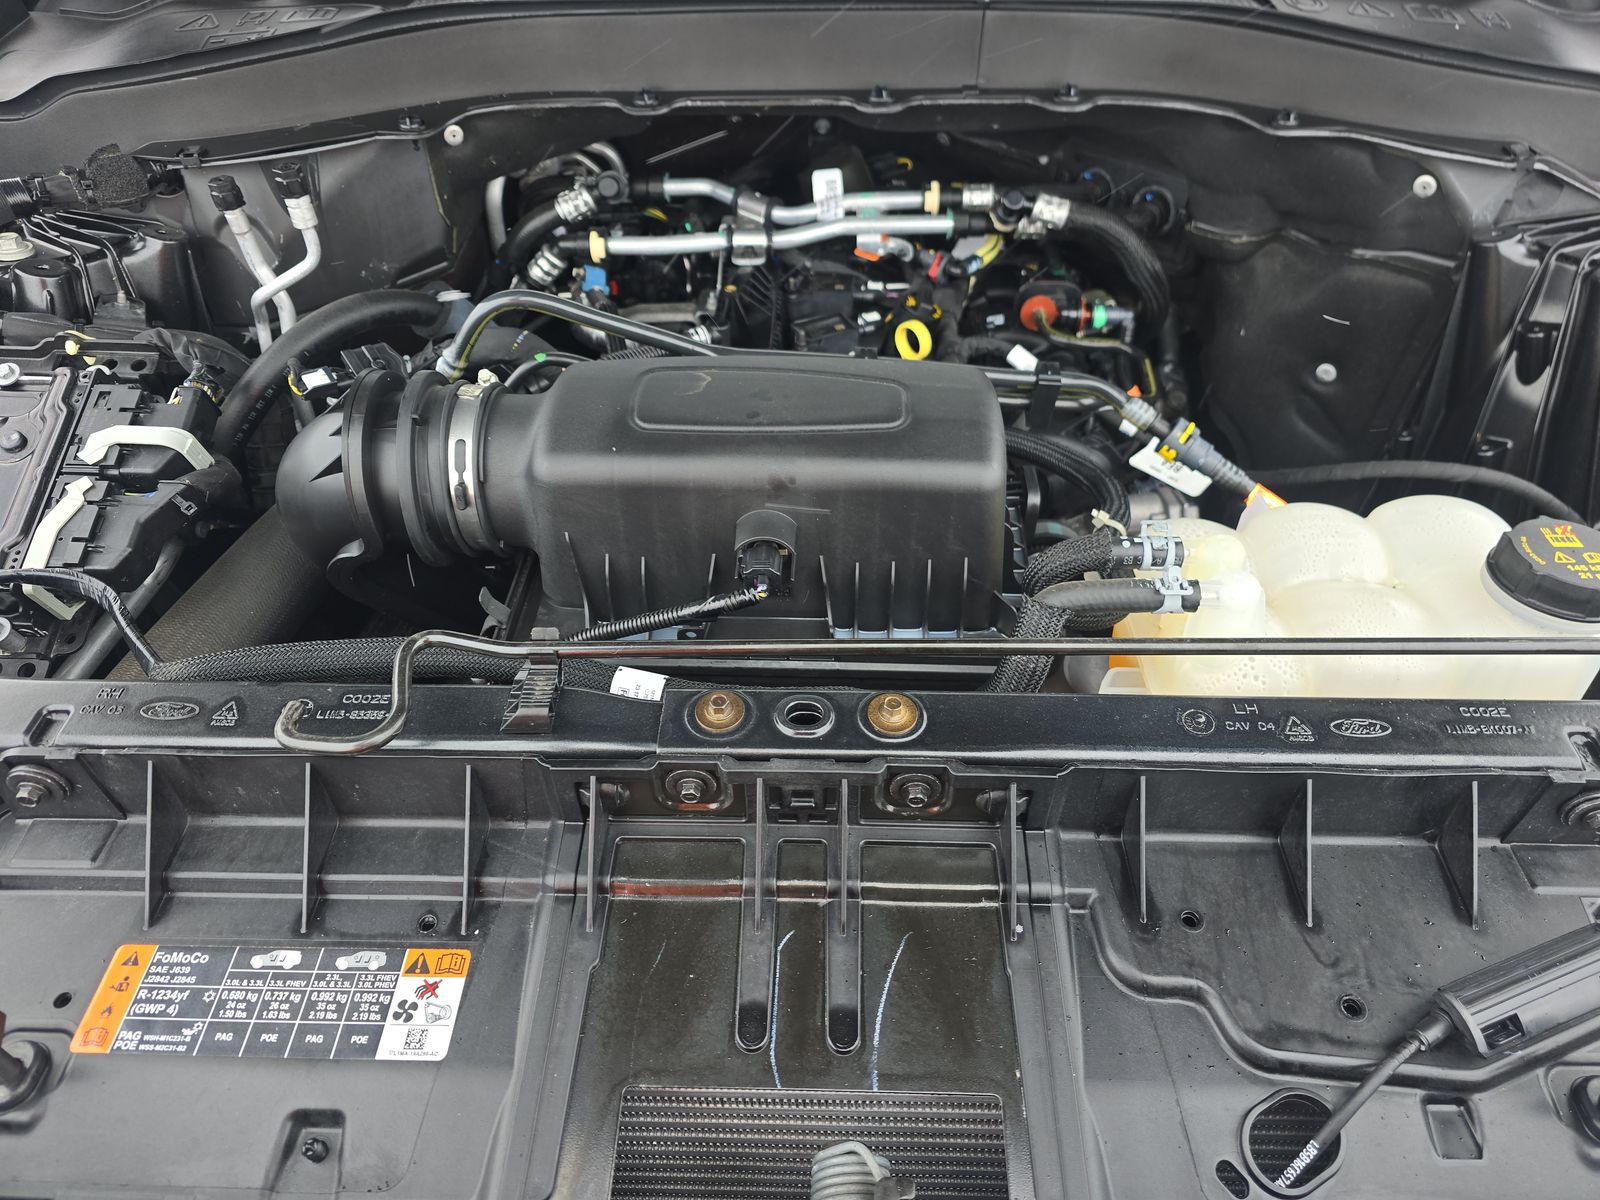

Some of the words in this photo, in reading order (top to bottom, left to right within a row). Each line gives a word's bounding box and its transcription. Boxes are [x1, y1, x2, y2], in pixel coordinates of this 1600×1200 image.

[96, 688, 126, 700] RH
[146, 702, 193, 718] Ford
[1232, 703, 1259, 714] LH
[1225, 721, 1250, 731] CAV
[1339, 719, 1383, 735] Ford
[152, 952, 210, 964] FoMoCo
[149, 966, 170, 974] SAE
[170, 966, 191, 974] J639
[170, 976, 197, 984] J2845
[136, 989, 190, 1002] R-1234yf
[221, 990, 246, 1000] 0.680
[246, 991, 258, 1002] kg
[264, 991, 289, 1001] 0.737
[289, 992, 302, 1003] kg
[311, 992, 335, 1001] 0.992
[336, 992, 348, 1004] kg
[354, 993, 378, 1002] 0.992
[379, 993, 391, 1004] kg
[225, 1001, 236, 1009] 24
[269, 1002, 279, 1010] 26
[316, 1002, 326, 1010] 35
[359, 1003, 369, 1011] 35
[130, 1004, 165, 1015] (GWP
[166, 1004, 179, 1016] 4)
[219, 1010, 234, 1018] 1.50
[234, 1010, 247, 1018] lbs
[262, 1011, 278, 1019] 1.63
[278, 1011, 291, 1019] lbs
[308, 1011, 325, 1019] 2.19
[325, 1012, 338, 1020] lbs
[352, 1012, 368, 1020] 2.19
[369, 1013, 381, 1021] lbs
[118, 1031, 142, 1040] PAG
[214, 1033, 234, 1041] PAG
[260, 1034, 279, 1042] POE
[305, 1034, 324, 1043] PAG
[350, 1035, 369, 1044] POE
[113, 1041, 139, 1050] POE
